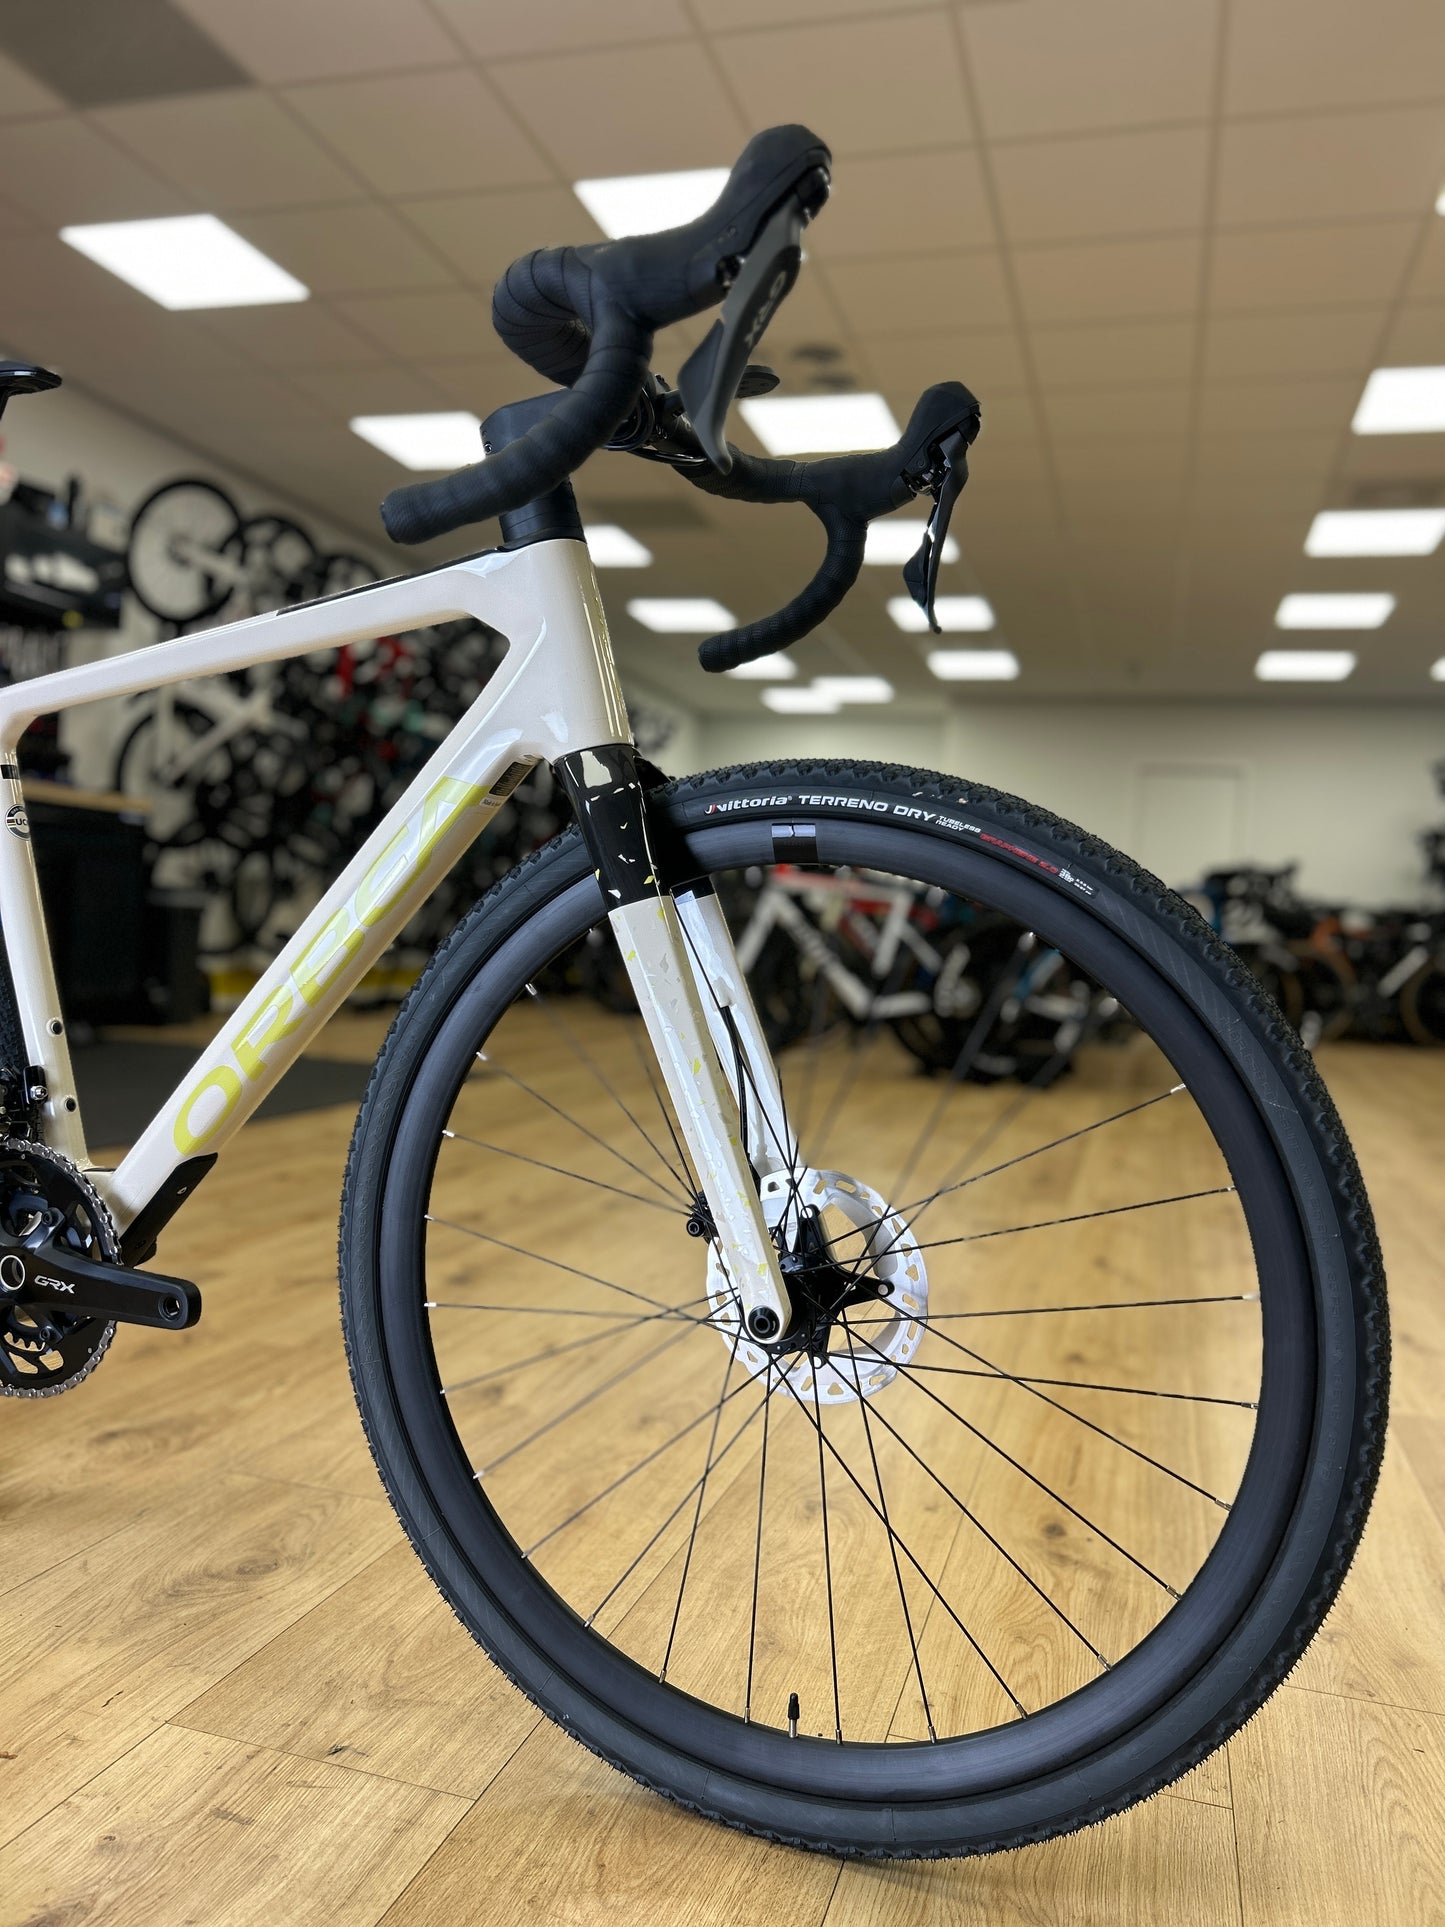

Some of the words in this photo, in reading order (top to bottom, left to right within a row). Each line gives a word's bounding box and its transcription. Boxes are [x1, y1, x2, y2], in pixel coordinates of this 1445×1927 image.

[798, 795, 888, 812] TERRENO
[893, 805, 936, 822] DRY
[173, 776, 491, 1155] ORBEA
[34, 1275, 76, 1294] GRX
